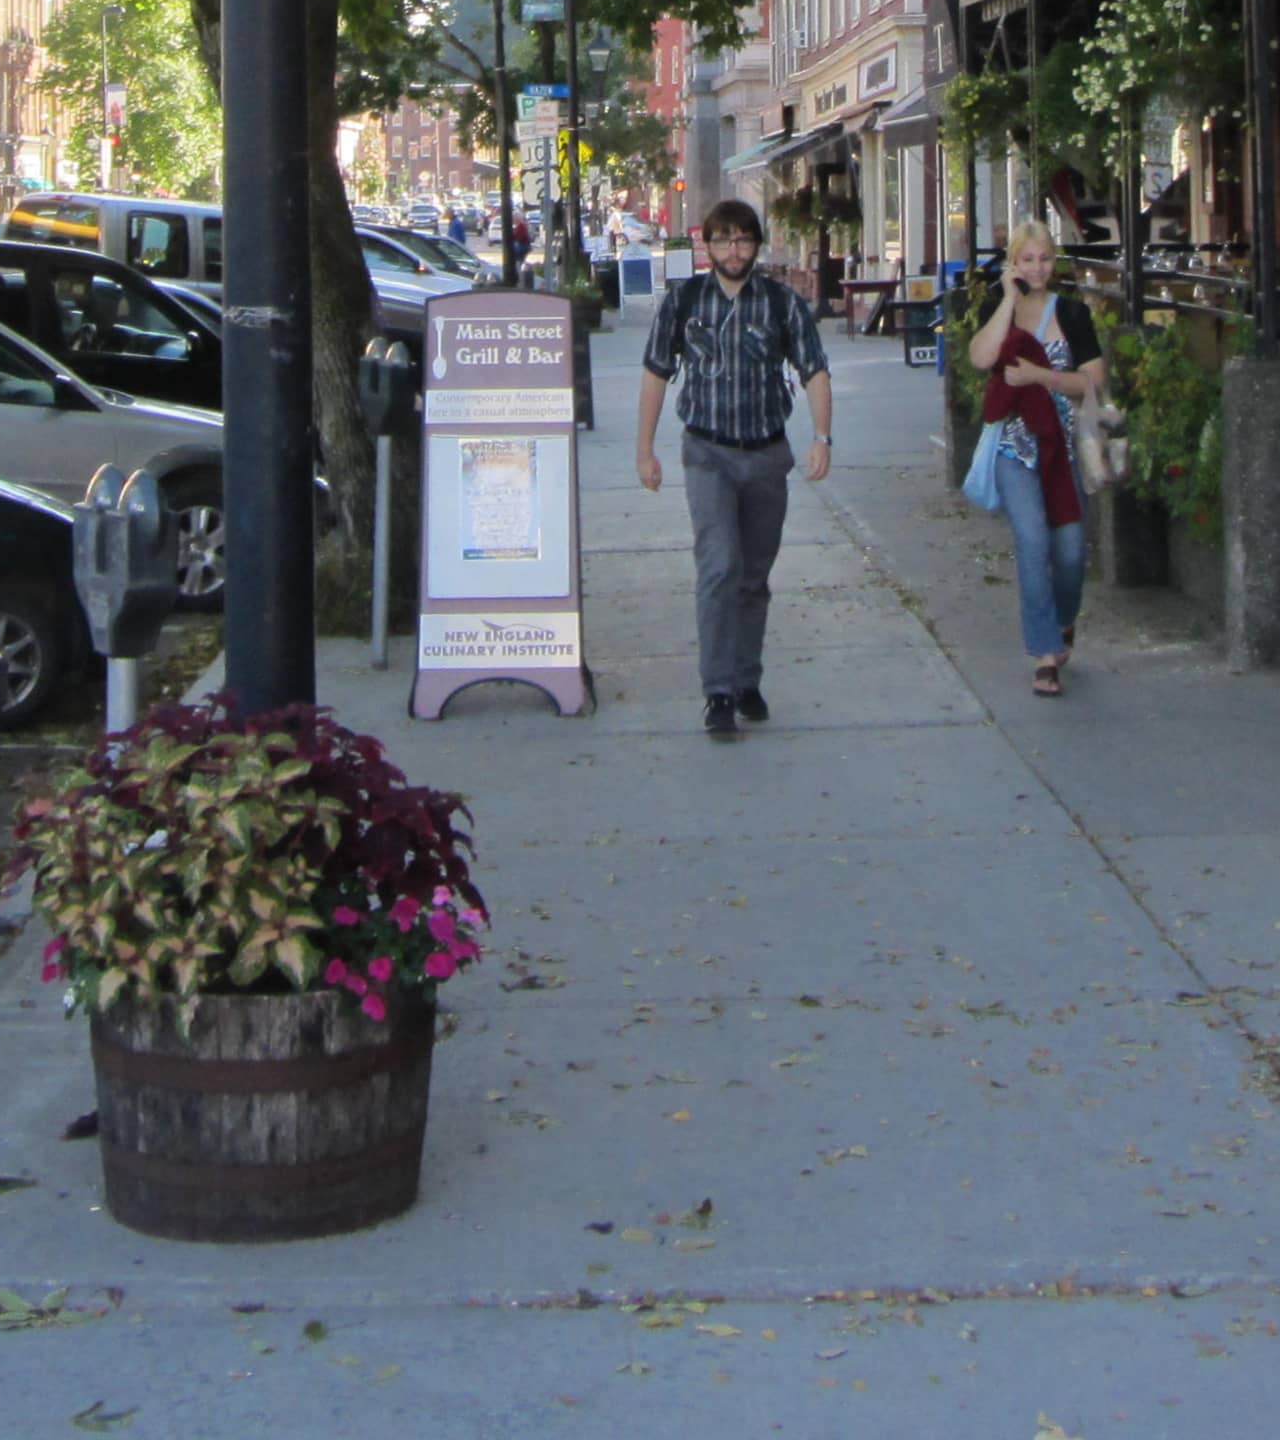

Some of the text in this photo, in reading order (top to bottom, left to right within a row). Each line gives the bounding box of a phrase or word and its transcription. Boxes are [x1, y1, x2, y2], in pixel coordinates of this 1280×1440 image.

[455, 322, 564, 340] Main Street
[455, 346, 564, 365] Grill & Bar
[444, 629, 556, 643] NEW ENGLAND
[423, 644, 574, 657] CULINARY INSTITUTE
